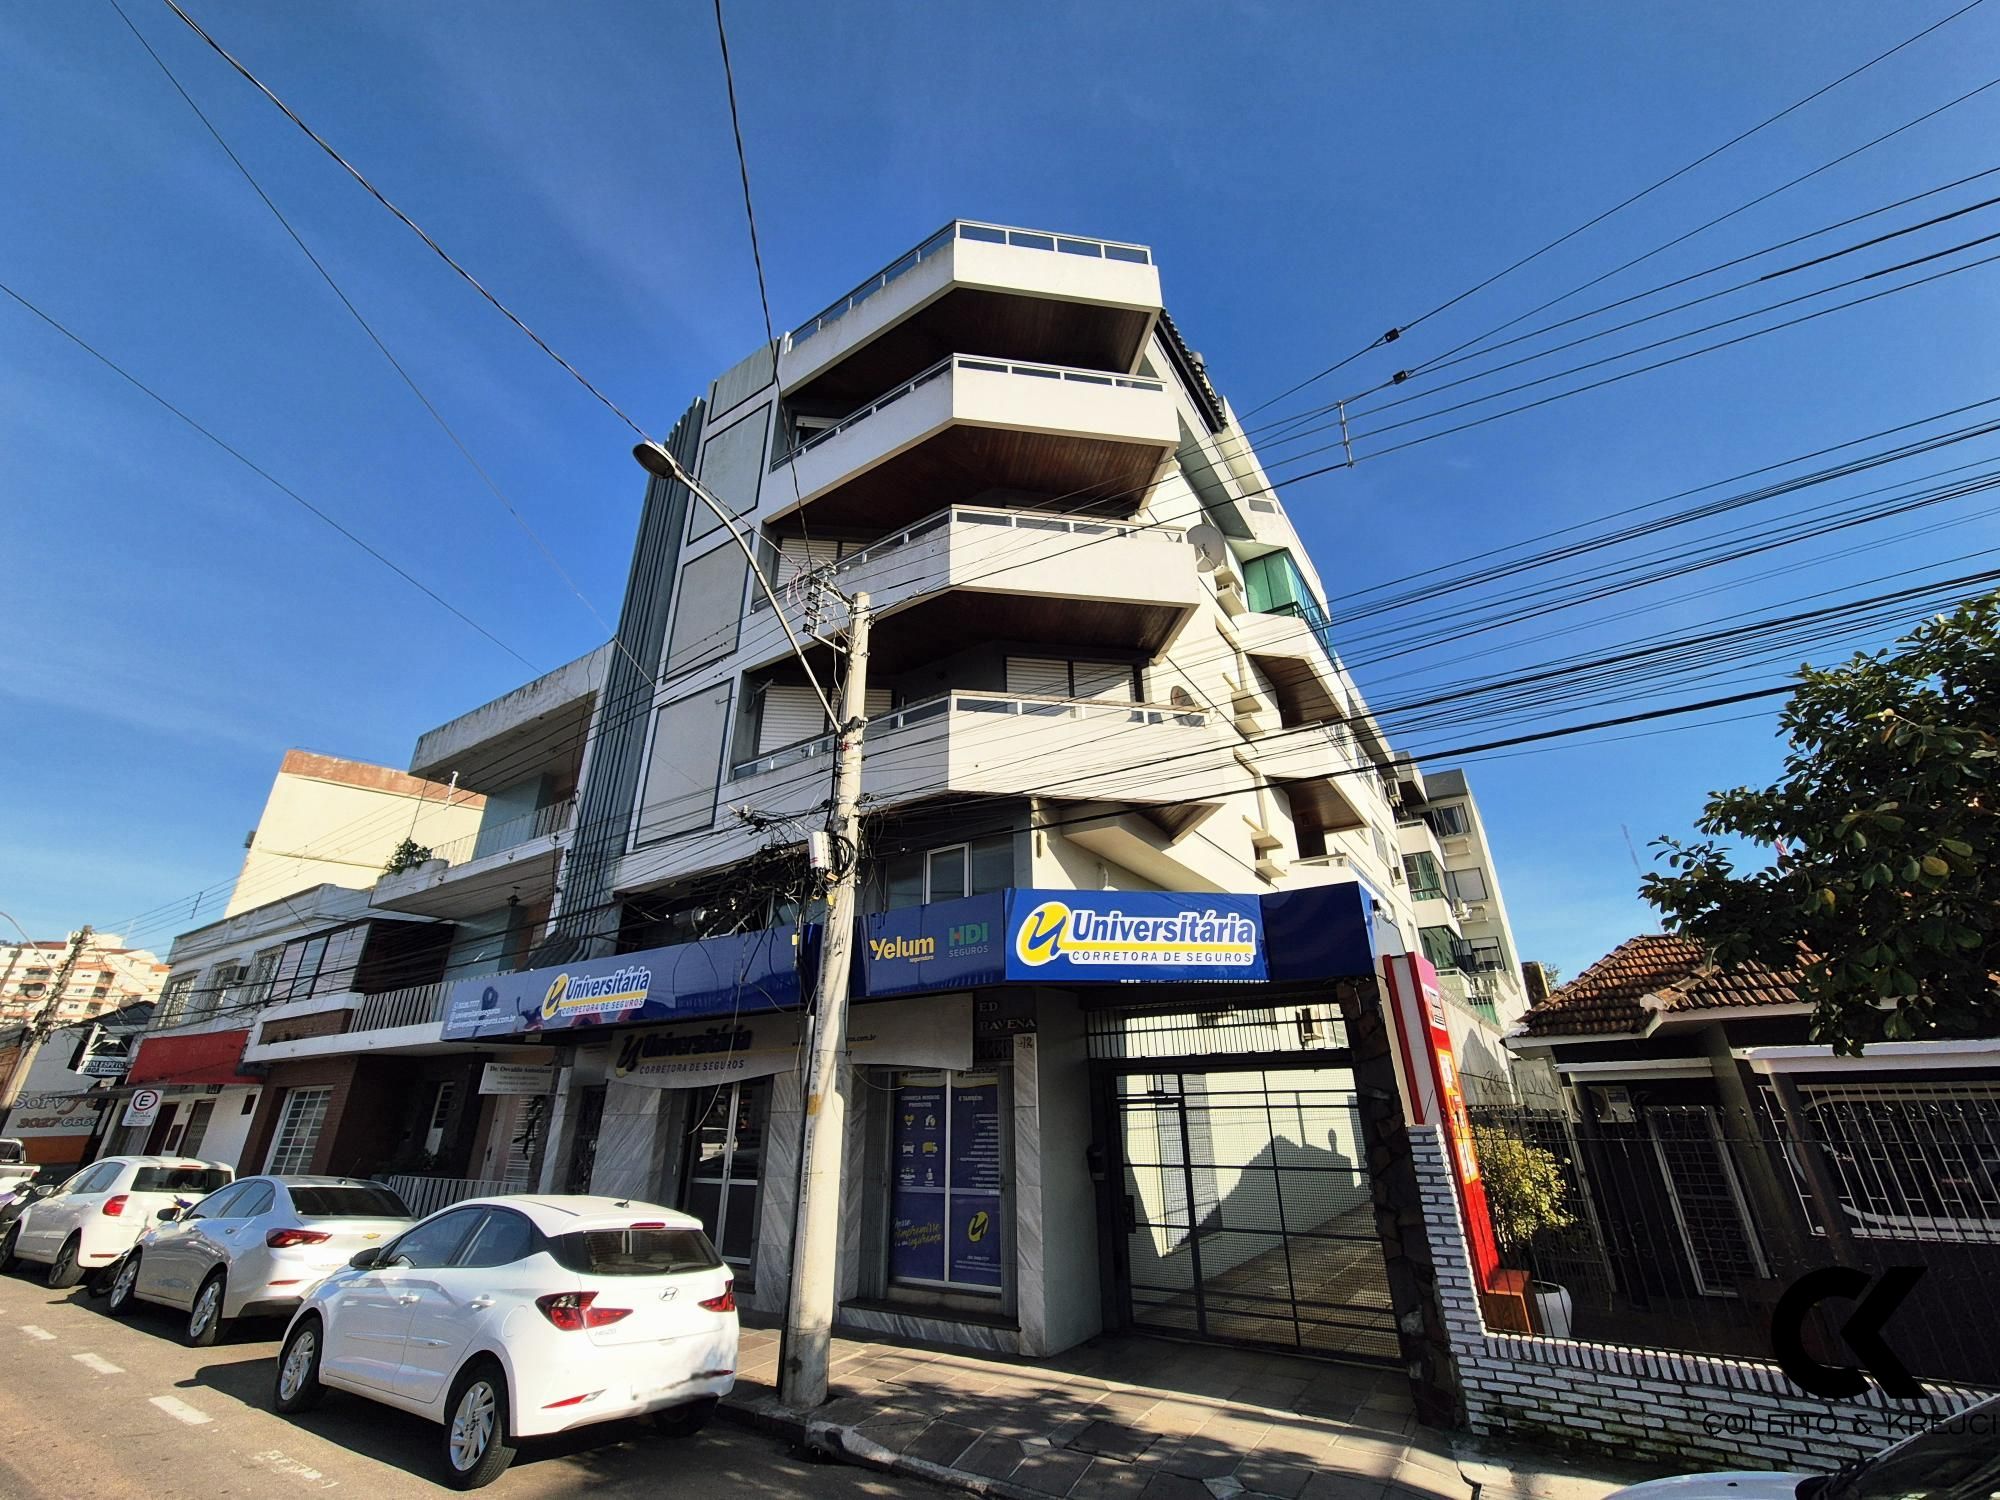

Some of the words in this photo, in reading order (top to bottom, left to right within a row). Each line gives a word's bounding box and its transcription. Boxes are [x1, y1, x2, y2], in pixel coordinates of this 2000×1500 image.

[948, 922, 989, 946] HDI
[1072, 910, 1251, 943] Universitária
[869, 936, 935, 961] Yelum
[948, 945, 990, 958] SEGUROS
[1072, 951, 1158, 962] CORRETORA
[1163, 952, 1182, 962] DE
[1189, 952, 1252, 963] SEGUROS
[565, 966, 650, 1000] Universitária
[561, 1005, 600, 1016] CORRETORA
[600, 1003, 609, 1011] DE
[611, 998, 644, 1009] SEGUROS
[978, 1001, 998, 1012] ED
[978, 1017, 1037, 1032] RAVENA
[642, 1024, 753, 1058] Universitária
[639, 1063, 687, 1075] CORRETORA
[689, 1062, 700, 1072] DE
[702, 1059, 745, 1072] SEGUROS
[138, 1095, 151, 1107] E
[16, 1116, 61, 1129] 3027
